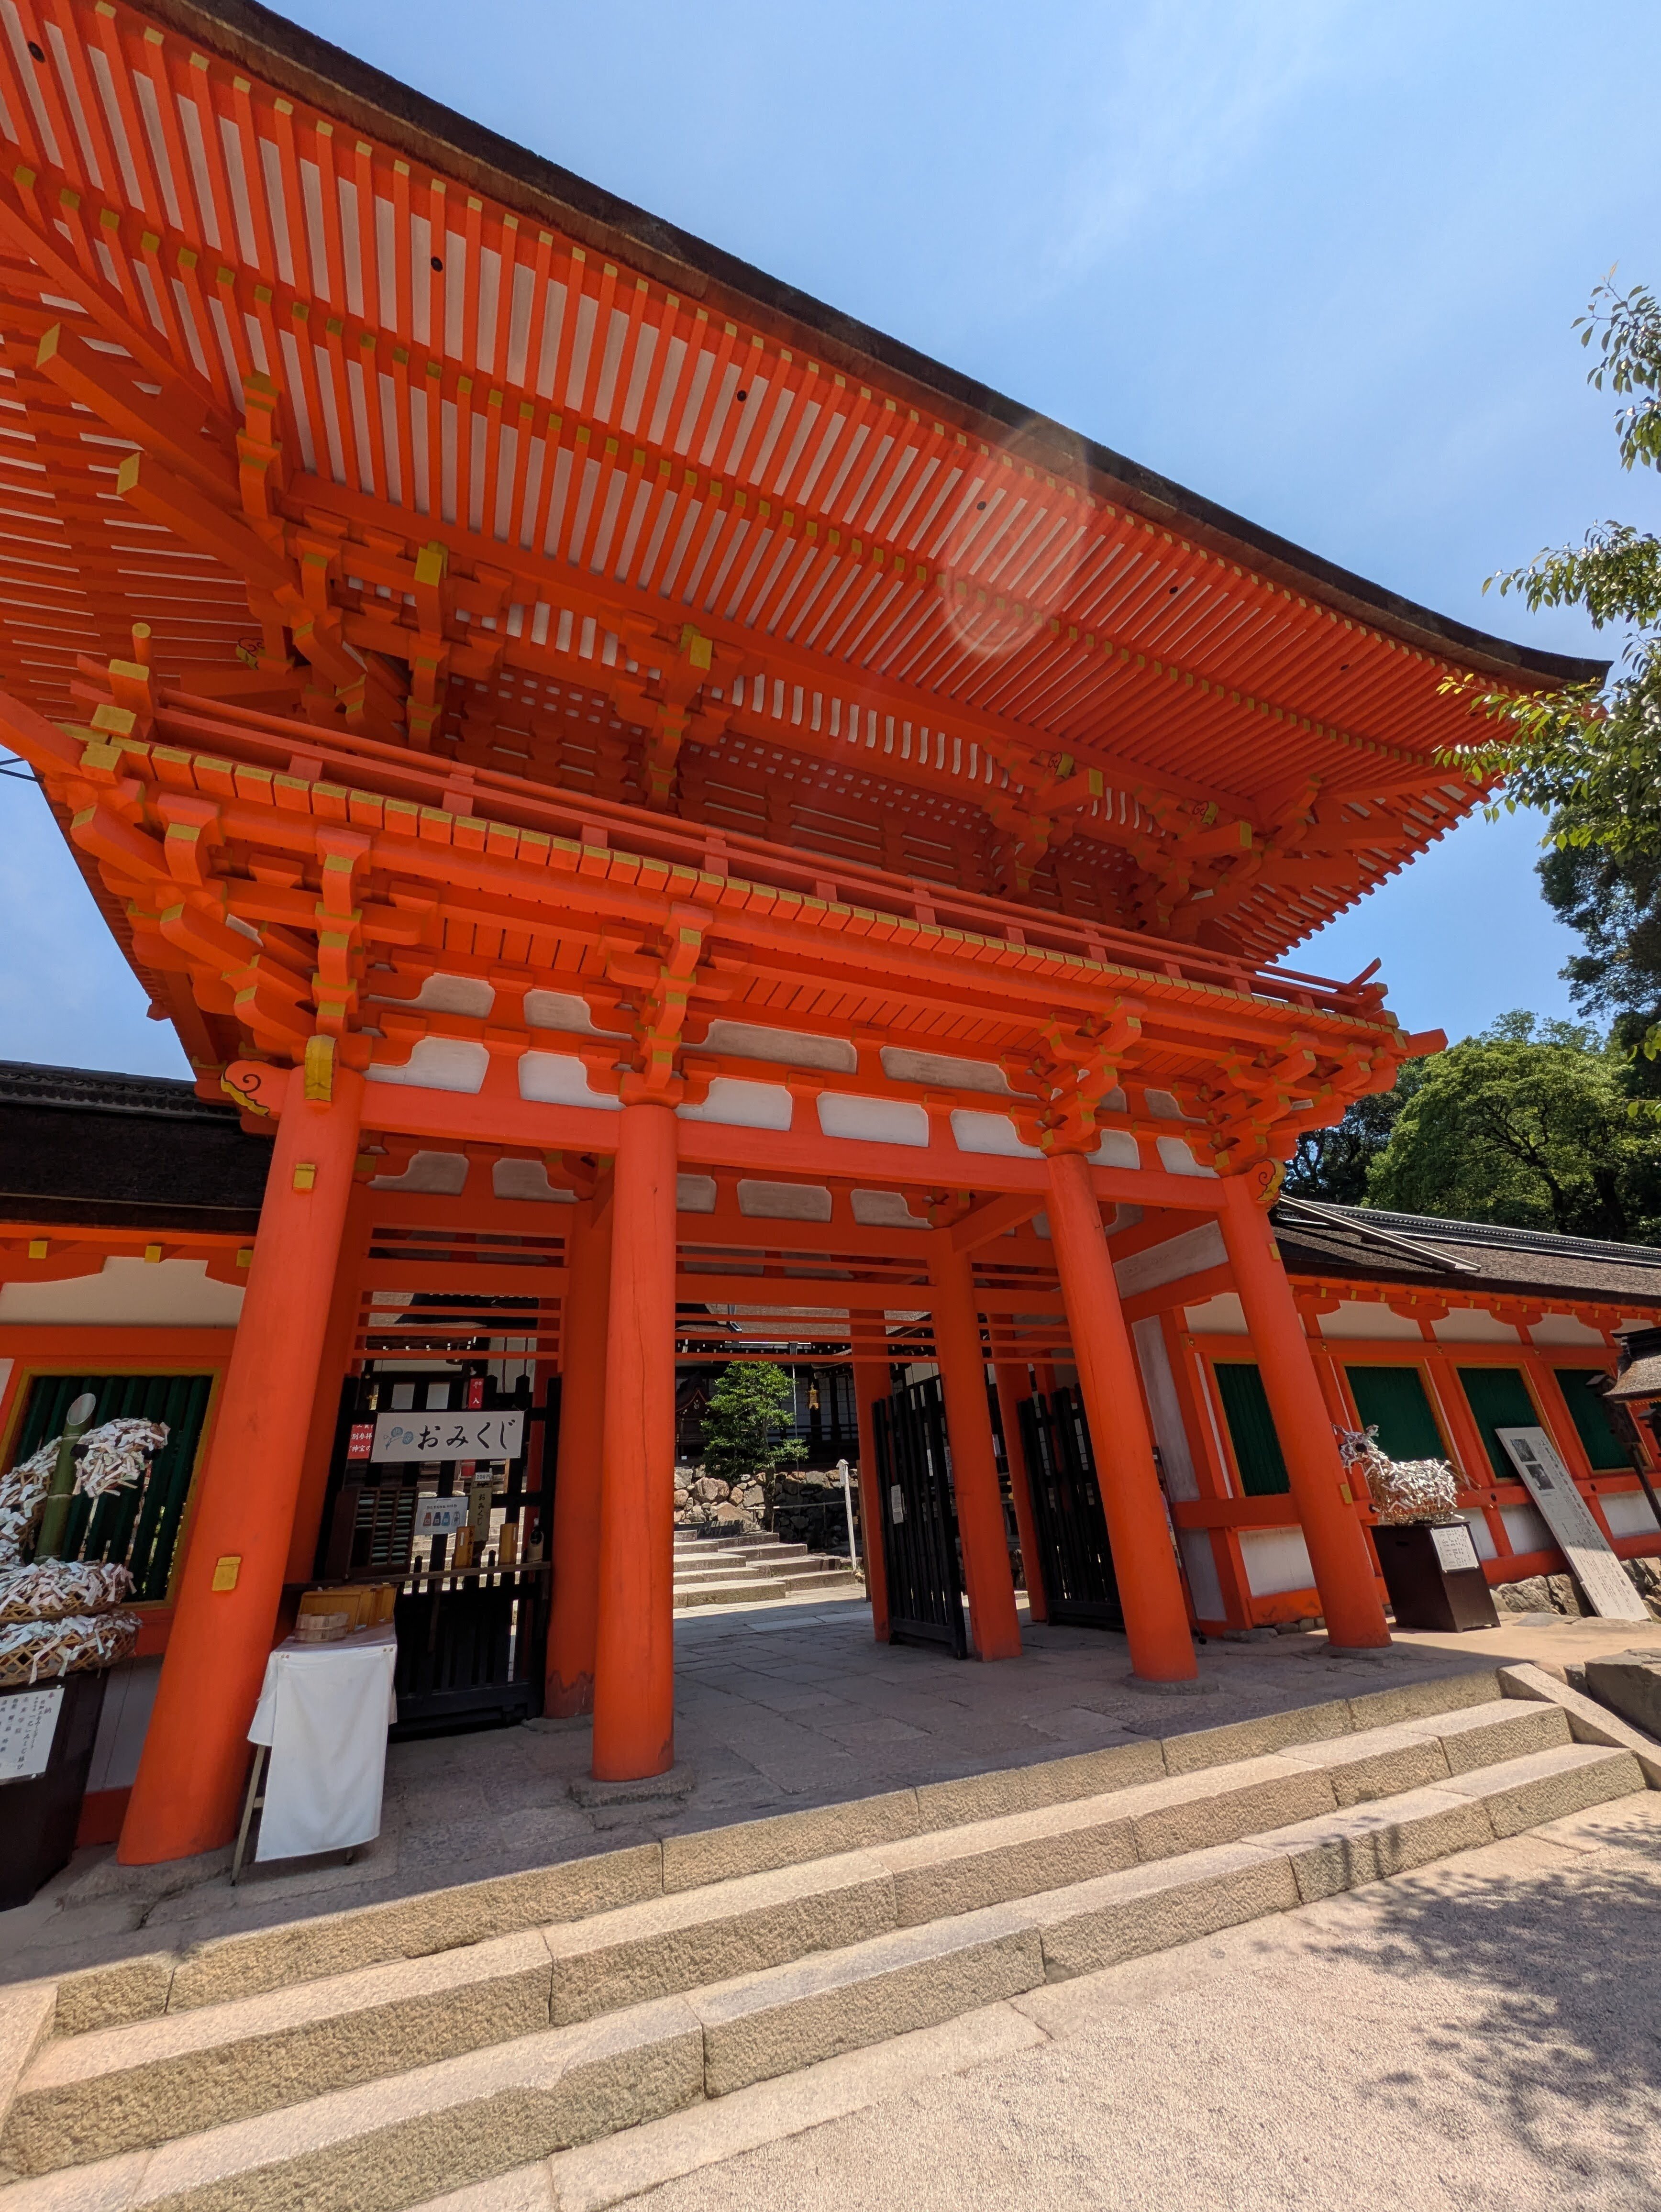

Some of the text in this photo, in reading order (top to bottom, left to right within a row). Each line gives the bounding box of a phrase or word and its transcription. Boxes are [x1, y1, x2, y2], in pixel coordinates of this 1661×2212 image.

[418, 1419, 516, 1450] おみくじ
[477, 1493, 486, 1526] おみくじ
